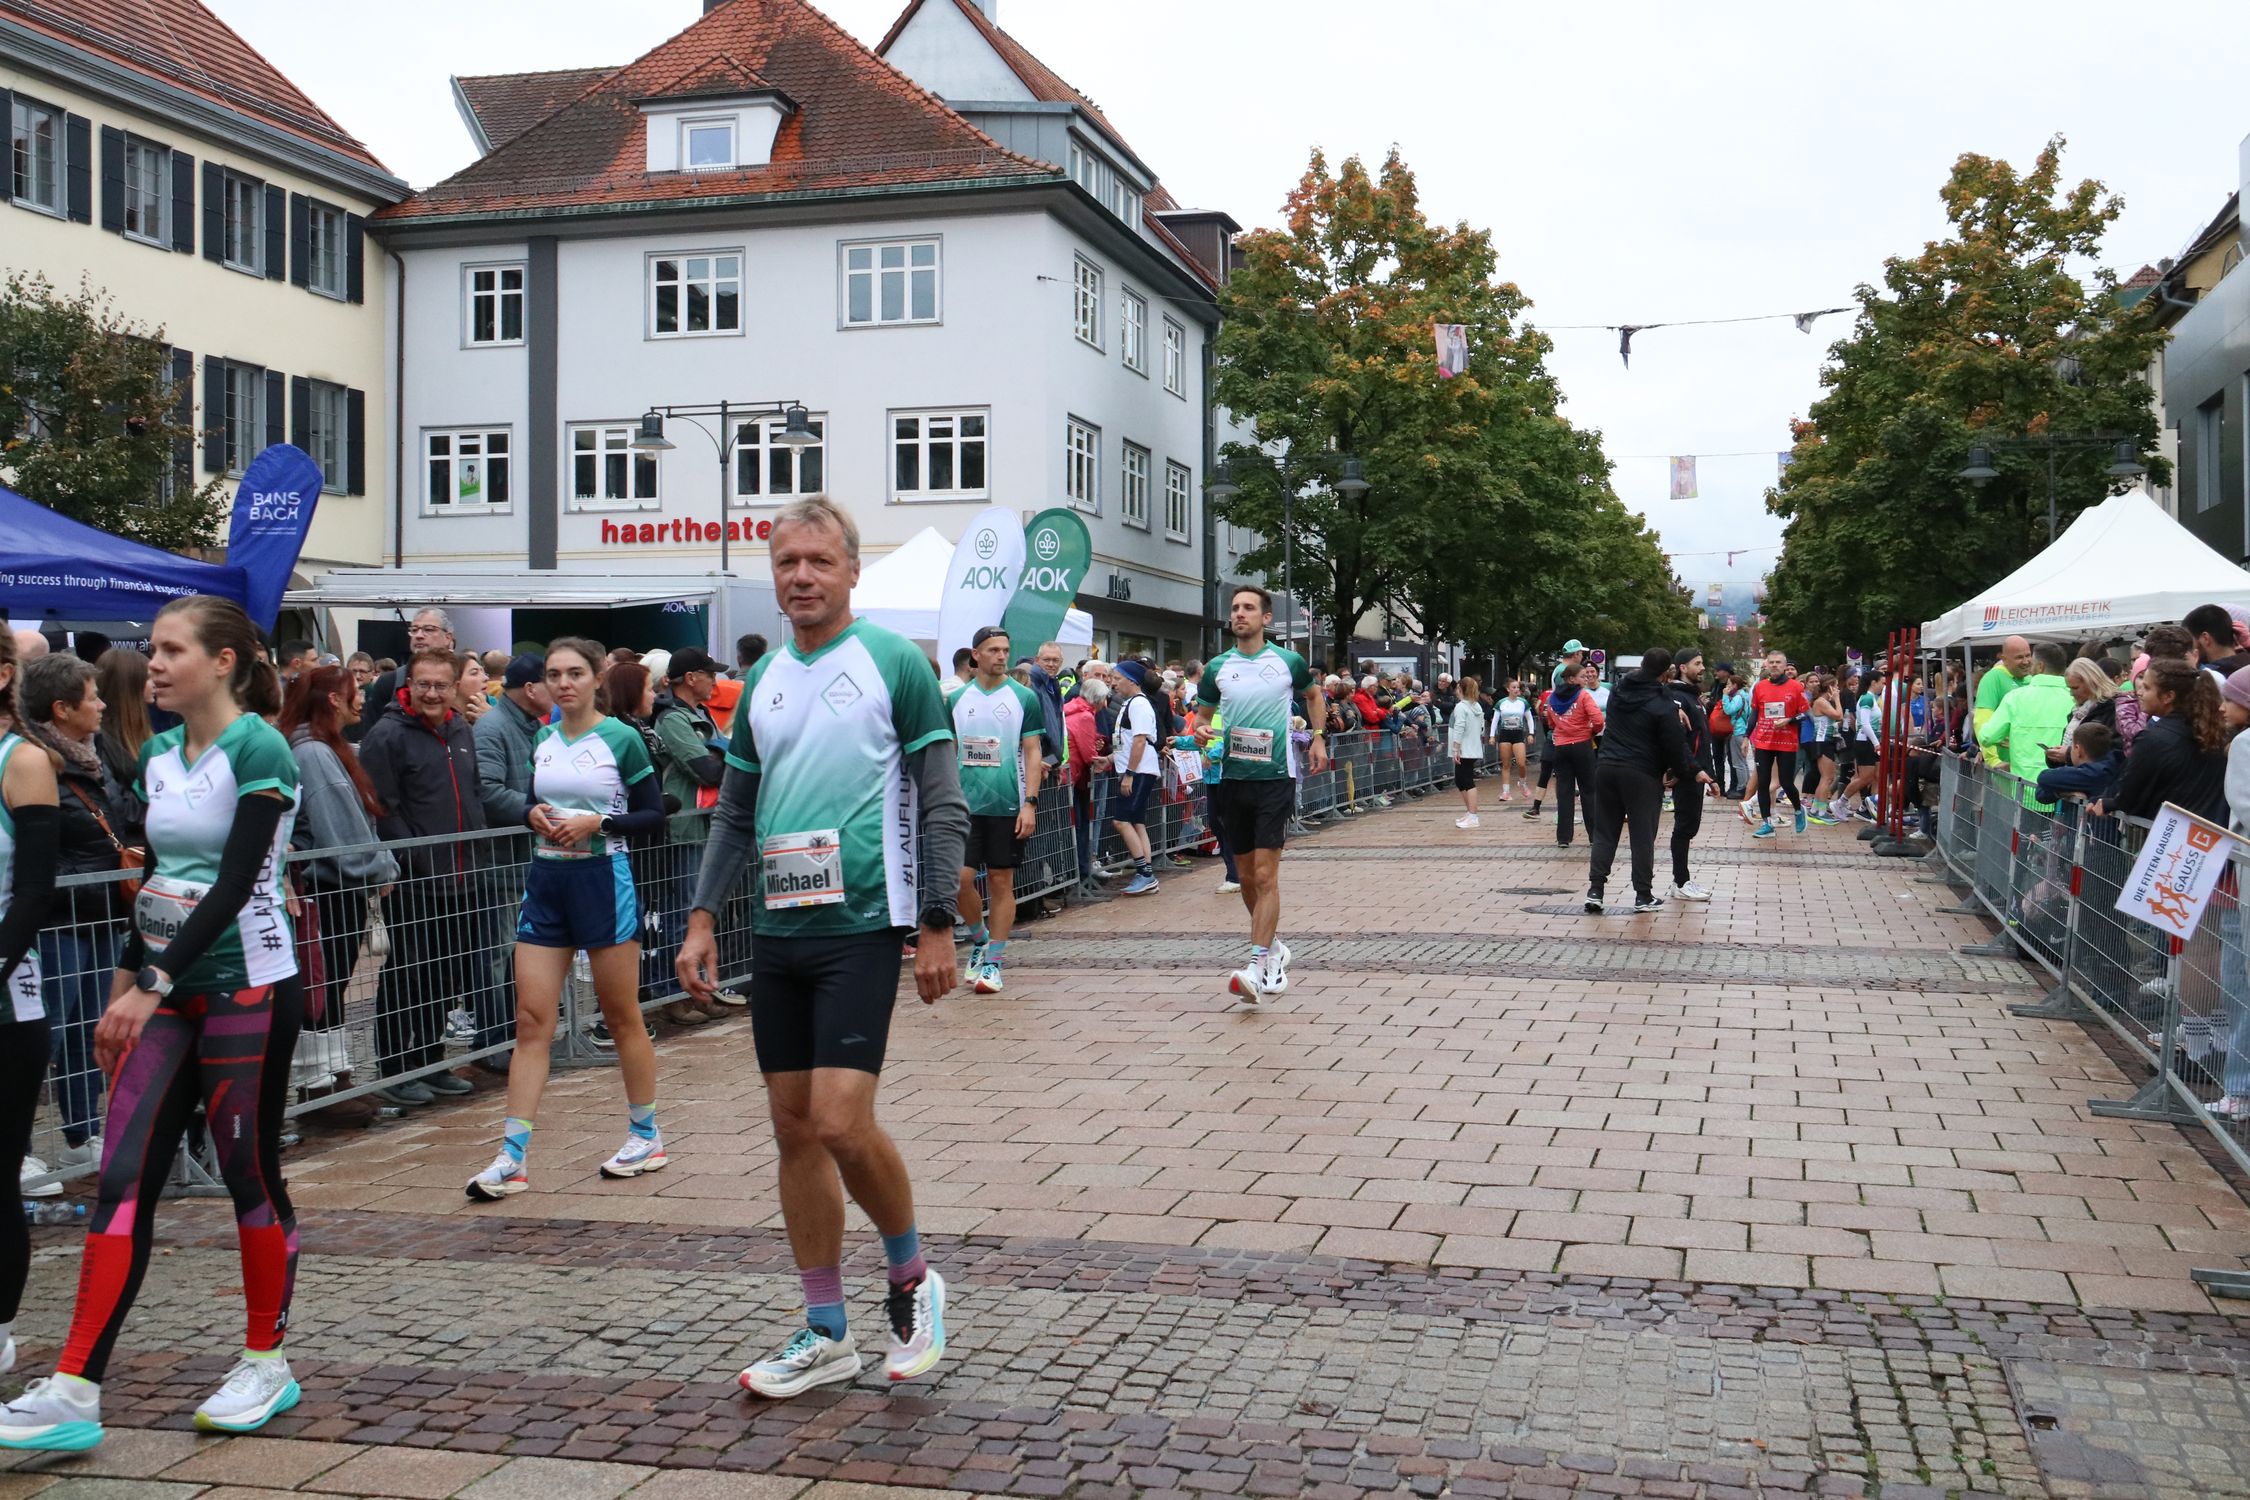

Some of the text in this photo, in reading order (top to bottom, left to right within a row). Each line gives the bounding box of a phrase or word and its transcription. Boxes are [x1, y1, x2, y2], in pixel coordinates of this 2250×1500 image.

[252, 491, 301, 506] BANS
[249, 507, 298, 520] BACH
[601, 517, 772, 544] haartheate
[17, 574, 61, 586] success
[64, 574, 107, 590] through
[110, 577, 154, 592] financial
[155, 584, 198, 596] expertise
[960, 566, 1007, 590] AOK
[1019, 566, 1072, 592] AOK
[2000, 601, 2112, 620] LEICHTATHLETIK
[967, 751, 991, 760] Robin
[1232, 743, 1267, 755] Michael
[2133, 818, 2178, 902] DIE FITTEN GAUSSIS
[2174, 849, 2199, 893] GAUSS
[766, 868, 831, 895] Michael
